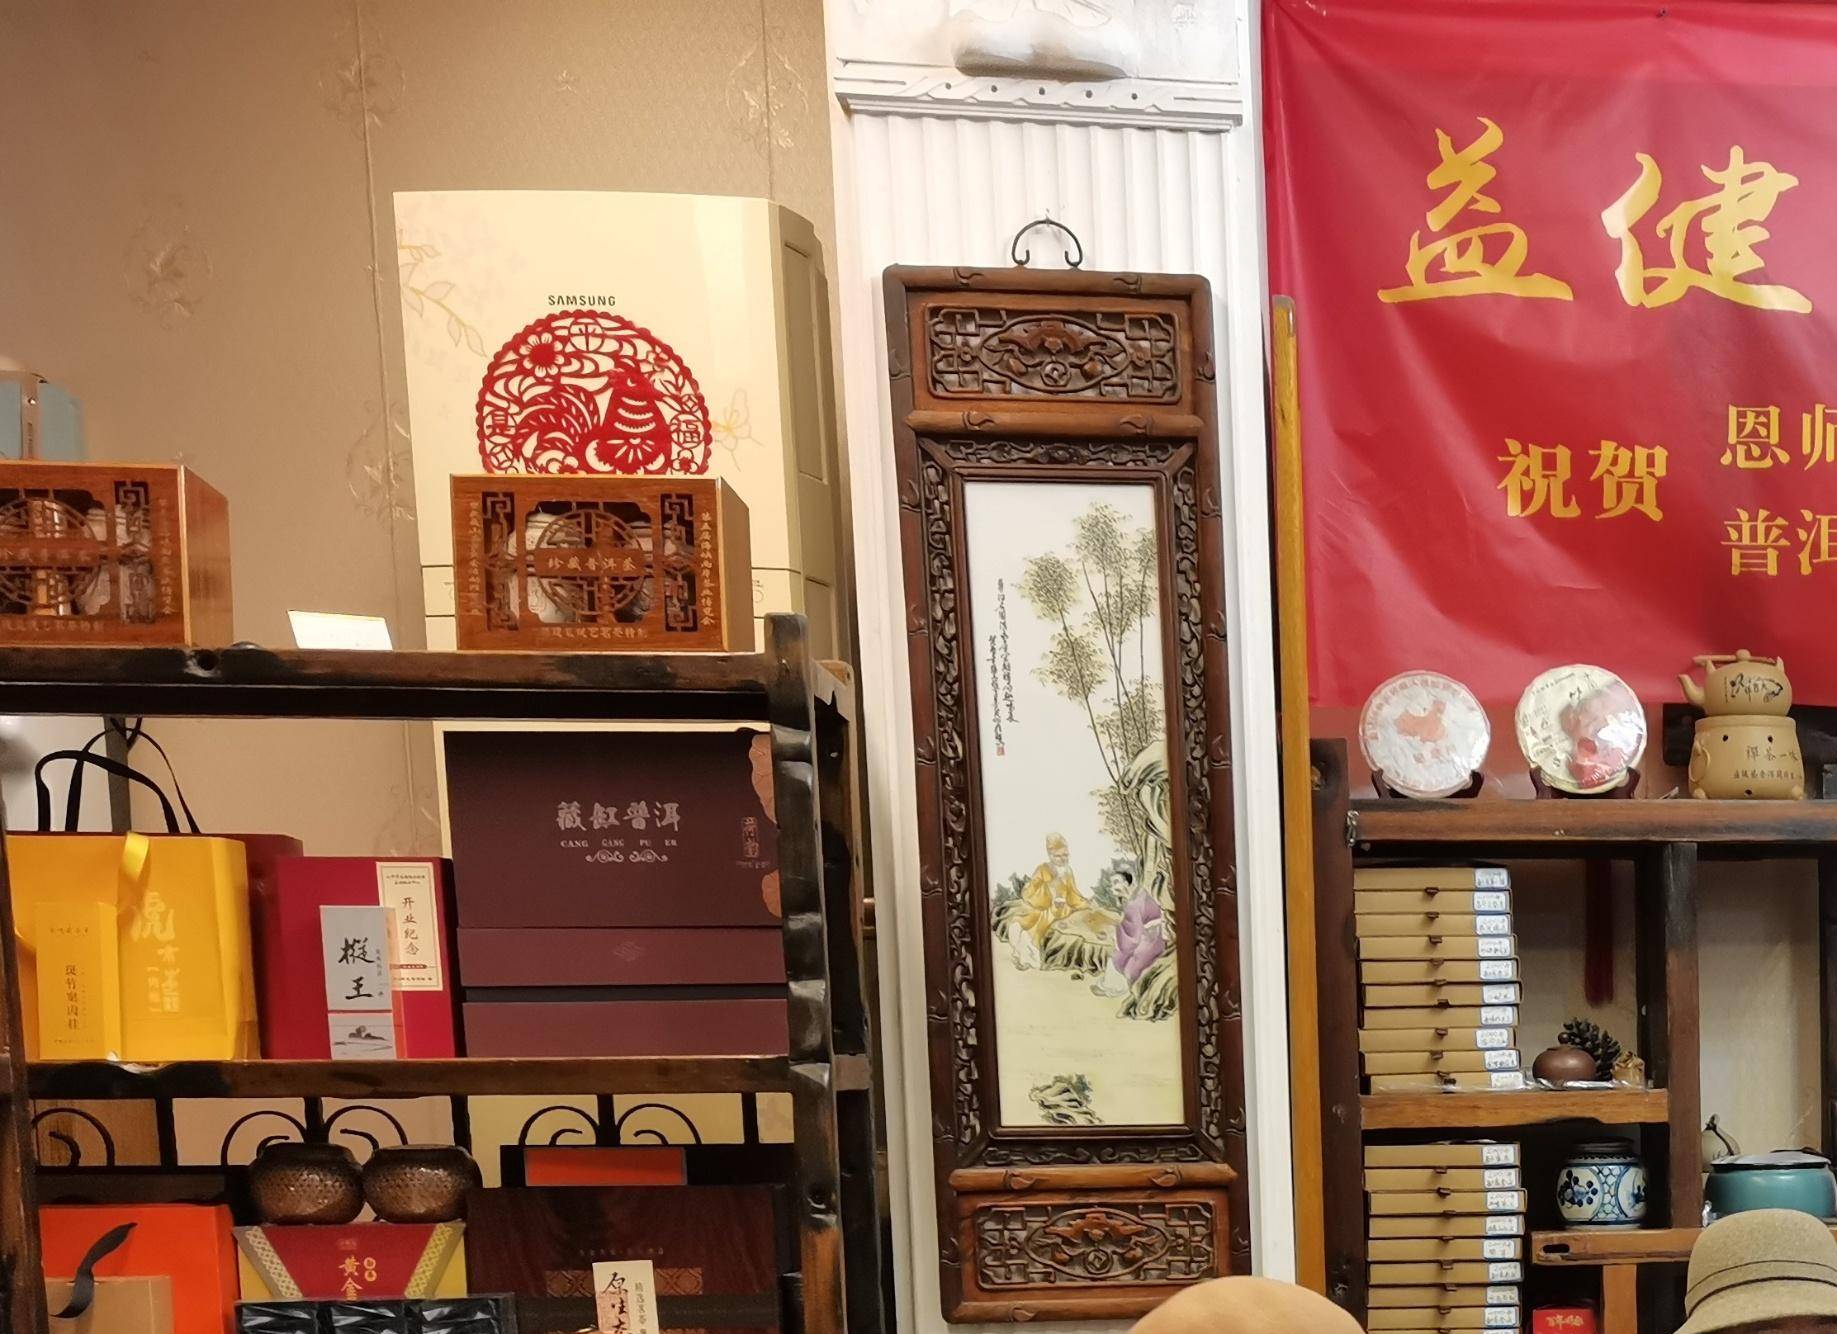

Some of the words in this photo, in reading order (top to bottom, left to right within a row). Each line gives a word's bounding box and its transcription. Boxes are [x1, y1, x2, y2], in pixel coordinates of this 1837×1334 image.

[547, 294, 617, 308] SAMSUNG
[1496, 438, 1670, 522] 祝贺
[560, 838, 589, 848] CANG
[401, 897, 420, 955] 开业纪念
